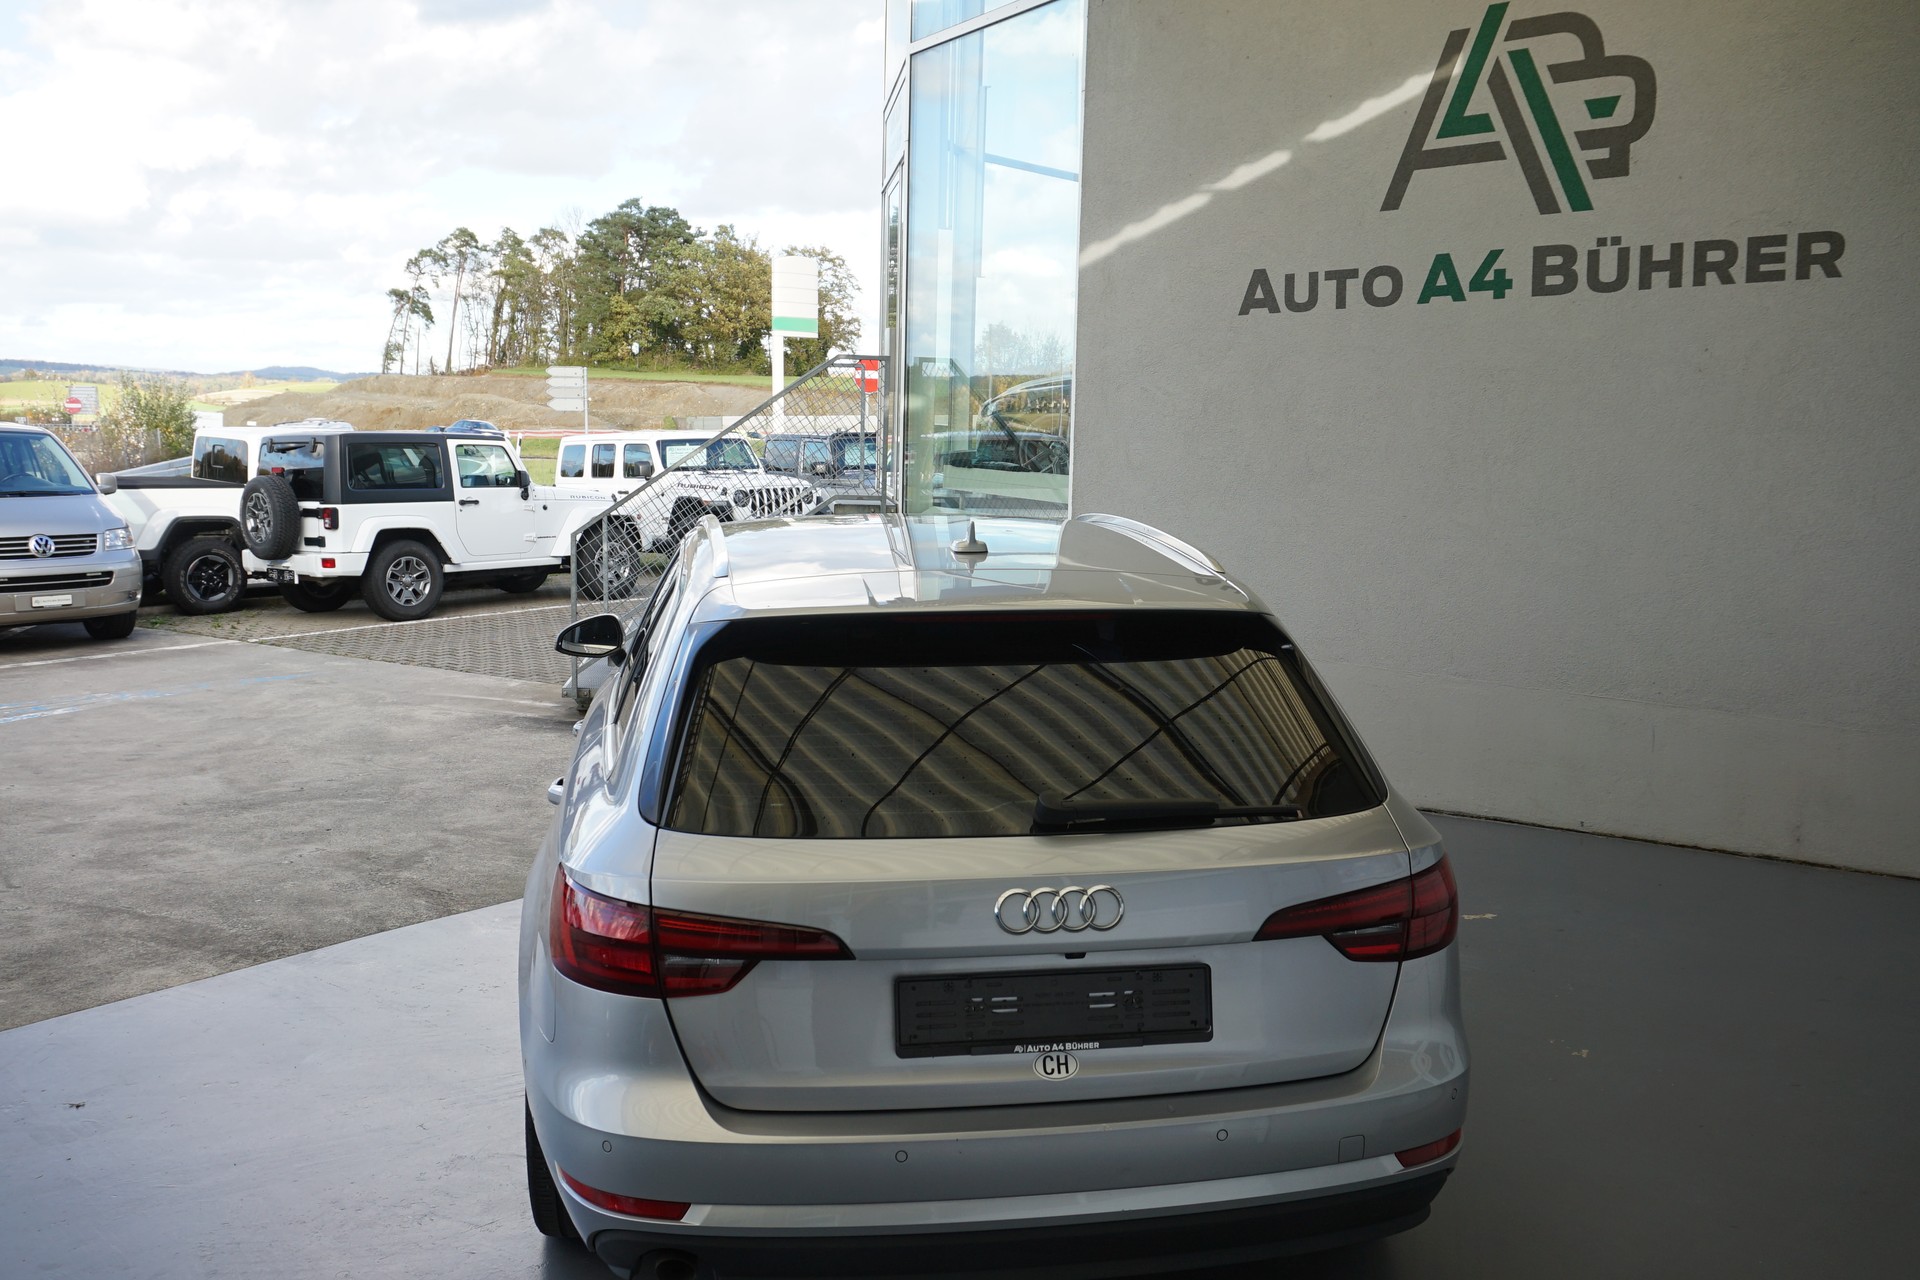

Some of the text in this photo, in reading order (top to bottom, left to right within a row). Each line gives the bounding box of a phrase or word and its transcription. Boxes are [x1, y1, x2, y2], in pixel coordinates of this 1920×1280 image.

[1238, 230, 1845, 316] AUTO A4 BÜHRER
[1027, 1044, 1050, 1053] AUTO
[1051, 1043, 1064, 1051] A4
[1065, 1042, 1099, 1050] BÜHRER
[1042, 1054, 1069, 1075] CH
